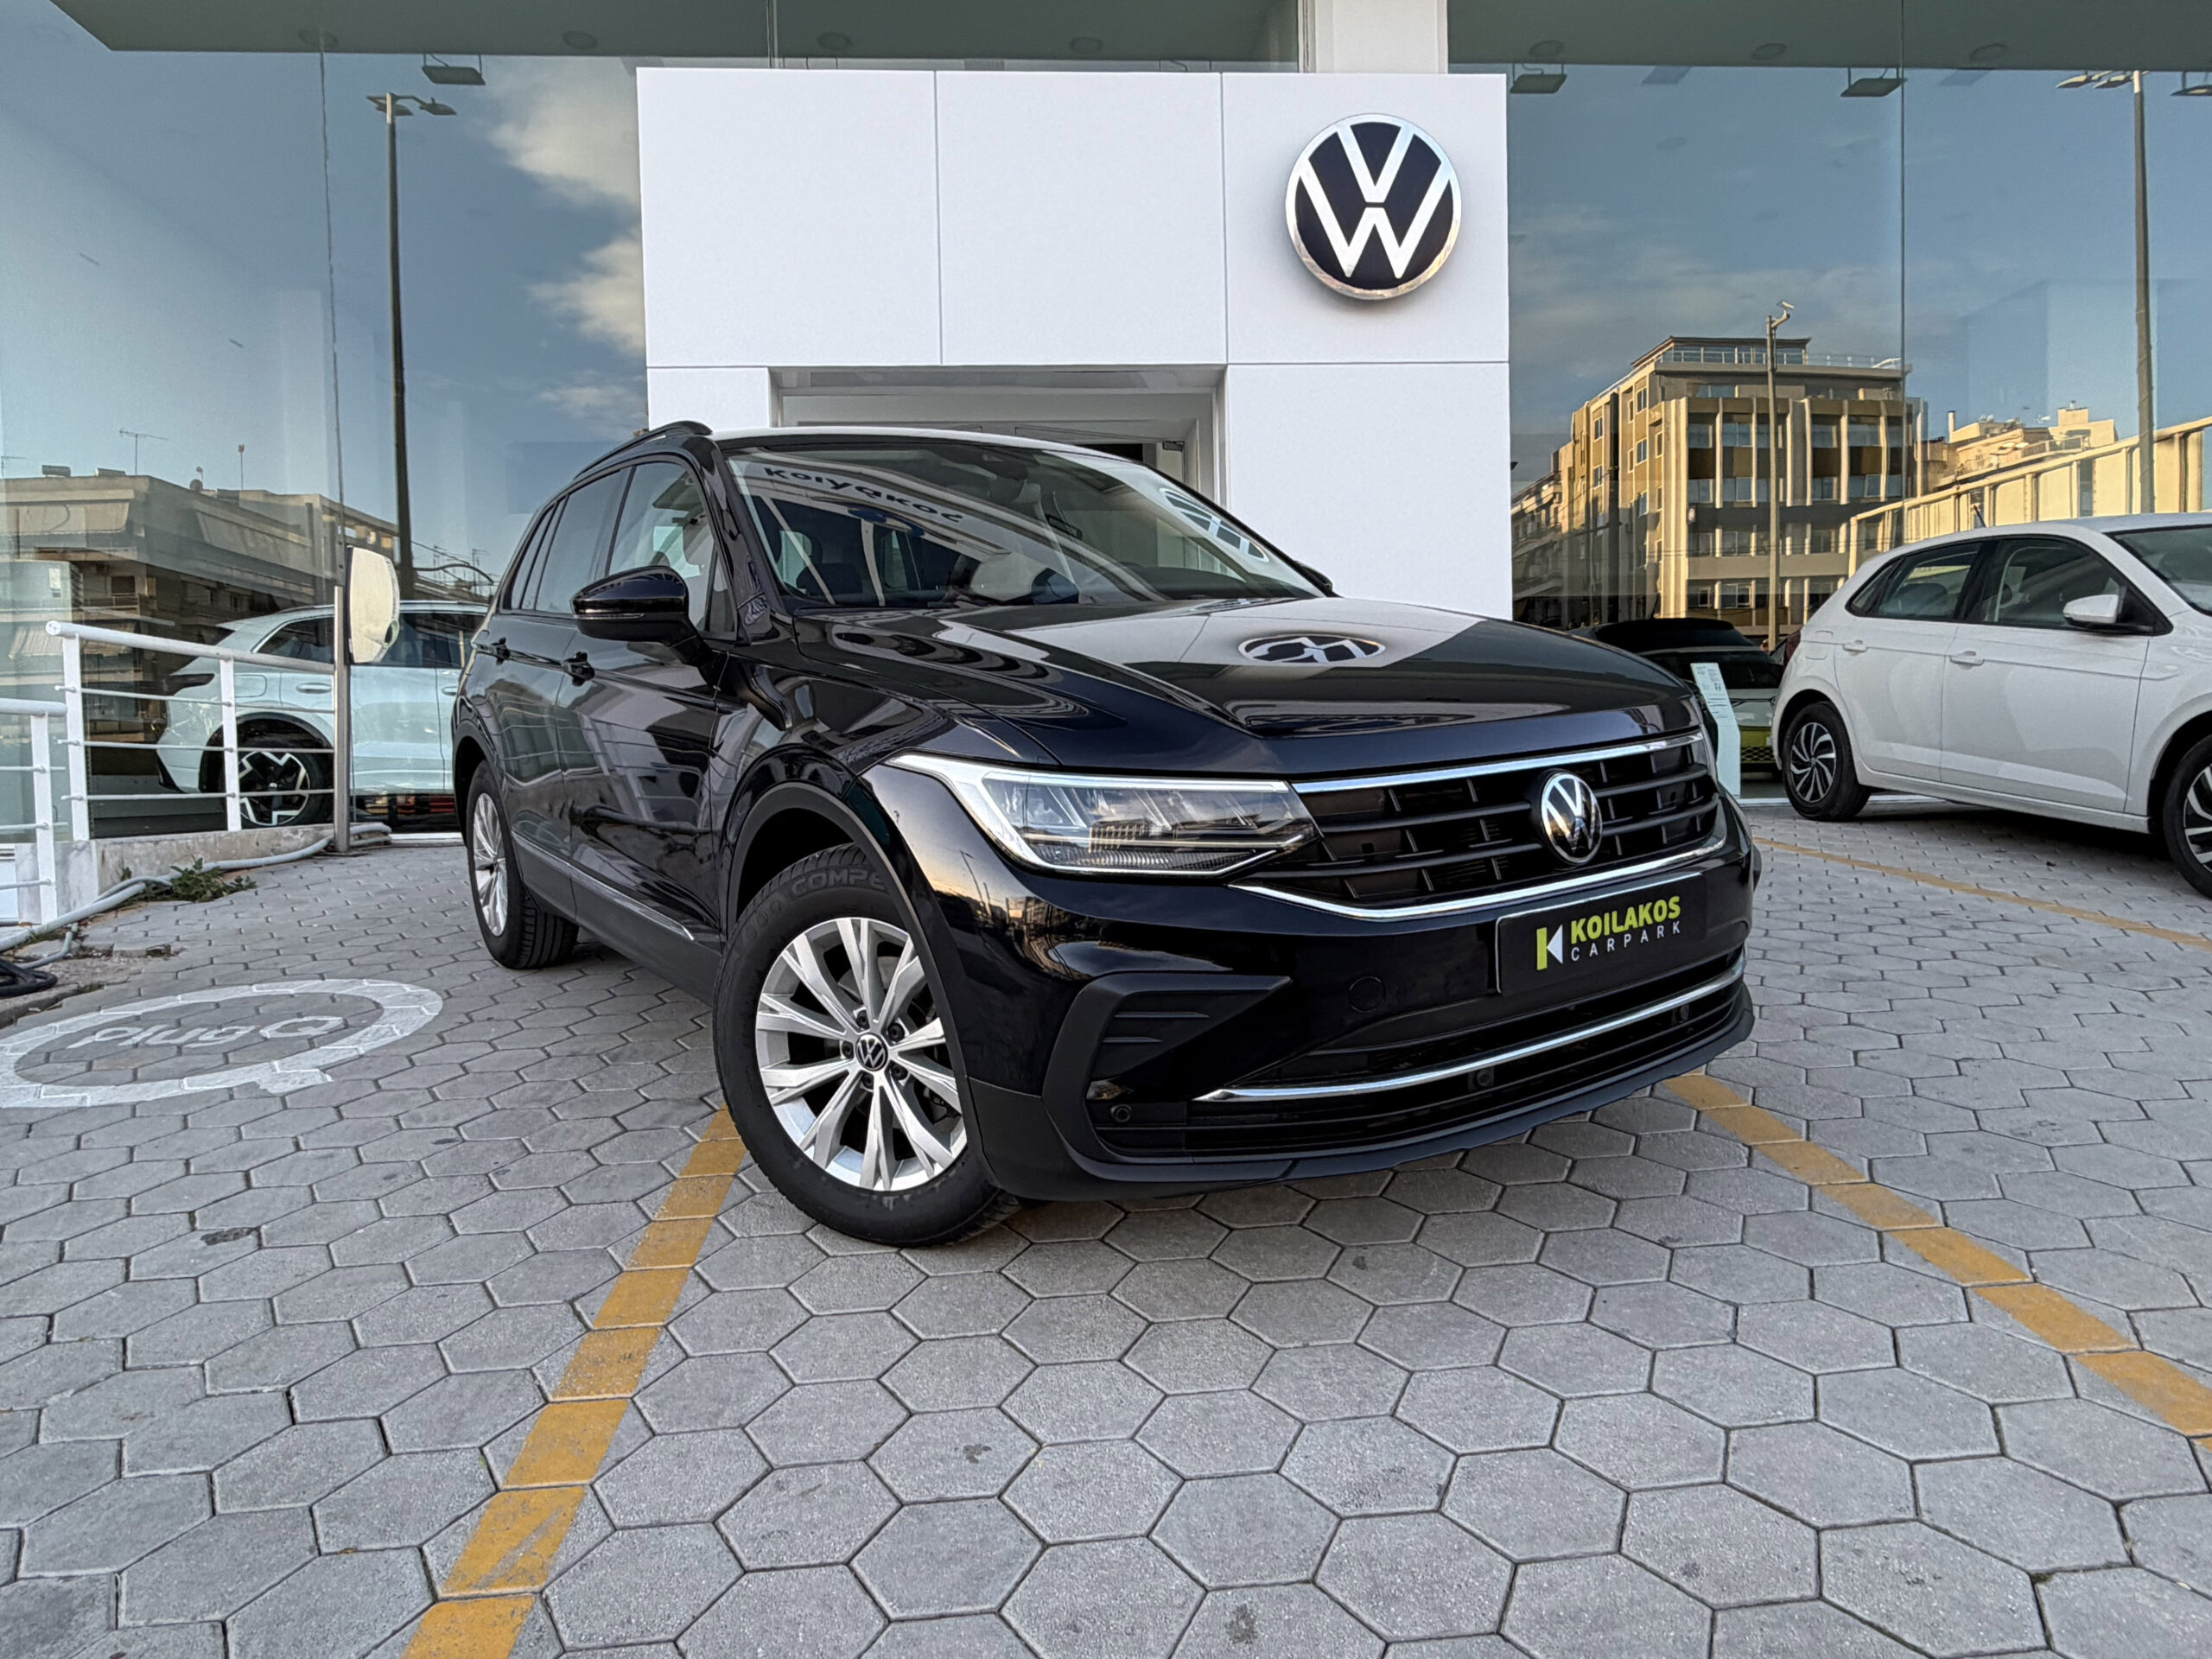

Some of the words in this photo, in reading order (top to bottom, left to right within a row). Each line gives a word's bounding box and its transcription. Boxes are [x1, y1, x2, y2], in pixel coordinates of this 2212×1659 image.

[1286, 113, 1461, 300] VW
[1571, 896, 1681, 944] KOILAKOS
[1571, 921, 1680, 961] CARPARK
